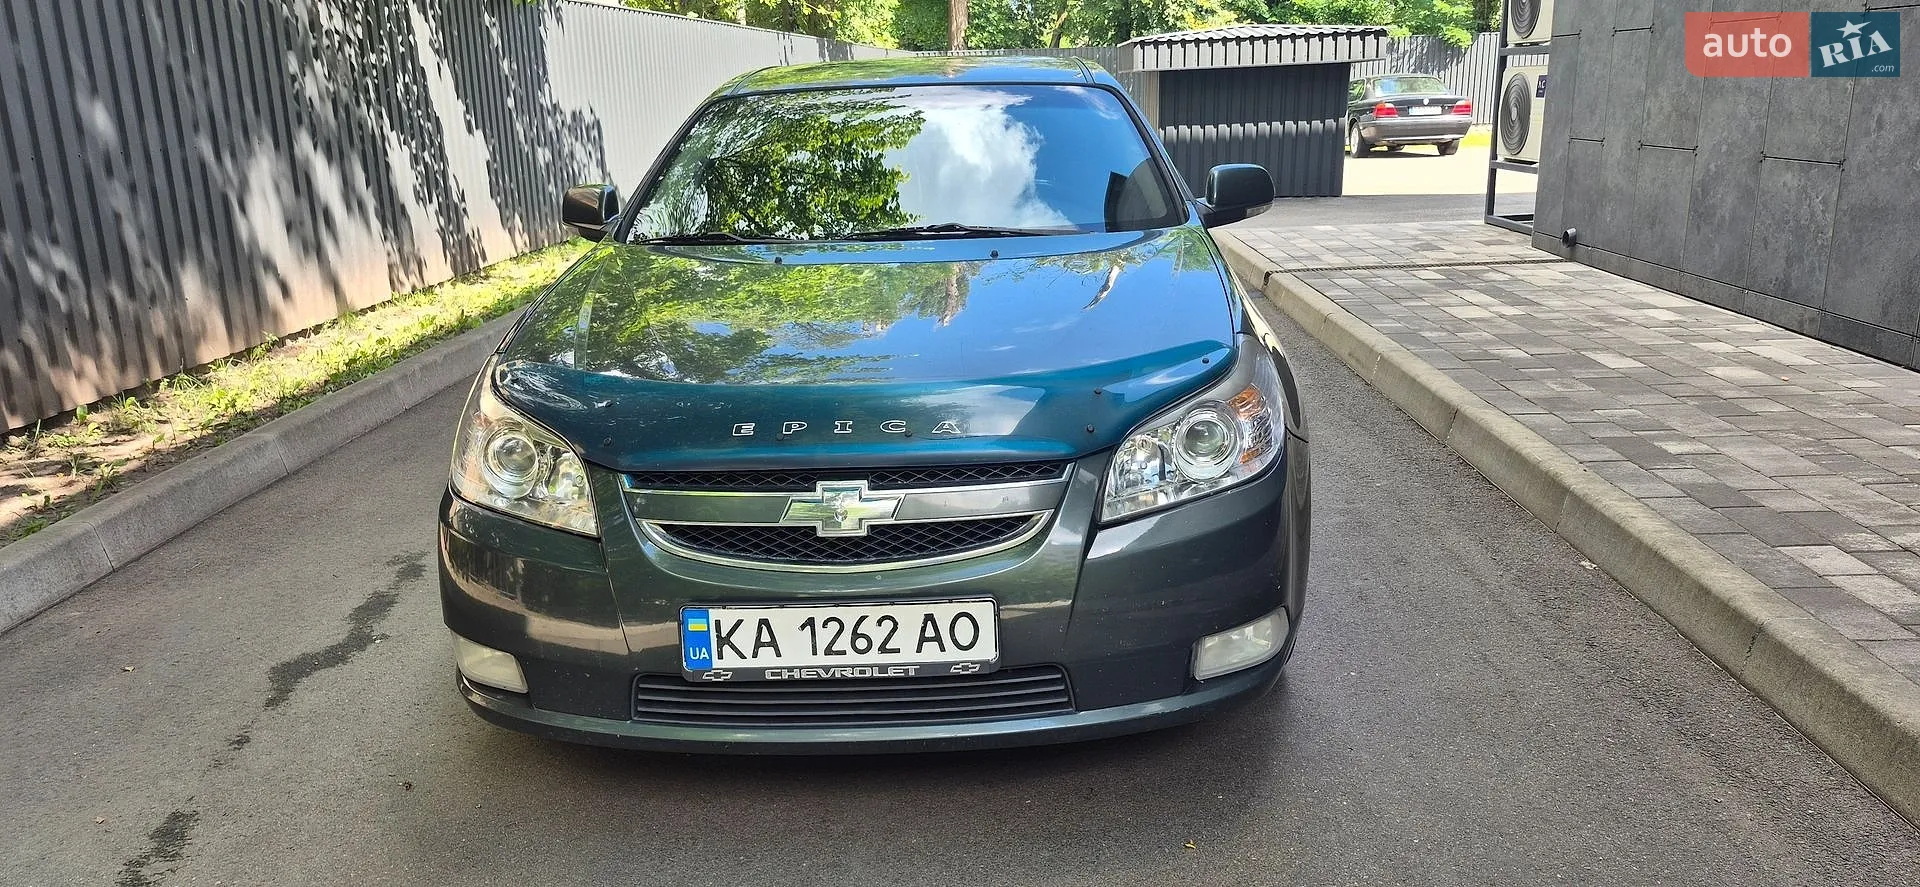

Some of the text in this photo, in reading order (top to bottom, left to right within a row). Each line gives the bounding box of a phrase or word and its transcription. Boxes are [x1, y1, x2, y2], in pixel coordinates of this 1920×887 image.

[732, 420, 961, 436] EPICA
[714, 611, 980, 660] KA 1262 AO
[689, 647, 710, 661] UA
[764, 665, 920, 680] CHEVROLET
